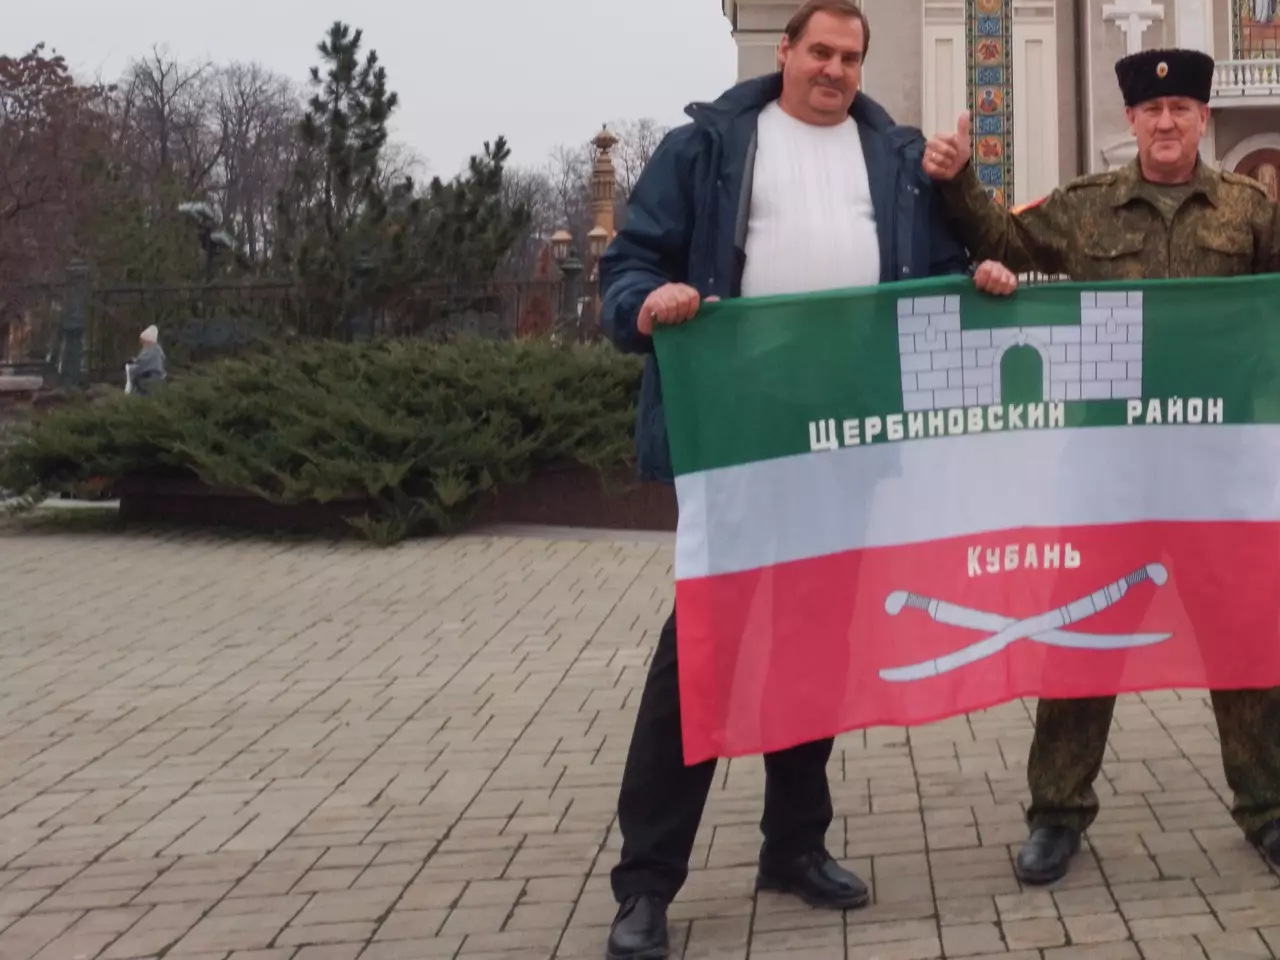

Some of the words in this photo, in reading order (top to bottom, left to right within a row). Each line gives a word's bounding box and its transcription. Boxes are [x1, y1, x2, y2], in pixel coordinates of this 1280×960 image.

[808, 401, 1065, 451] ЩЕРБИНОВСКИЙ
[1127, 396, 1224, 424] РАЙОН
[967, 543, 1081, 577] КУБАНЬ
